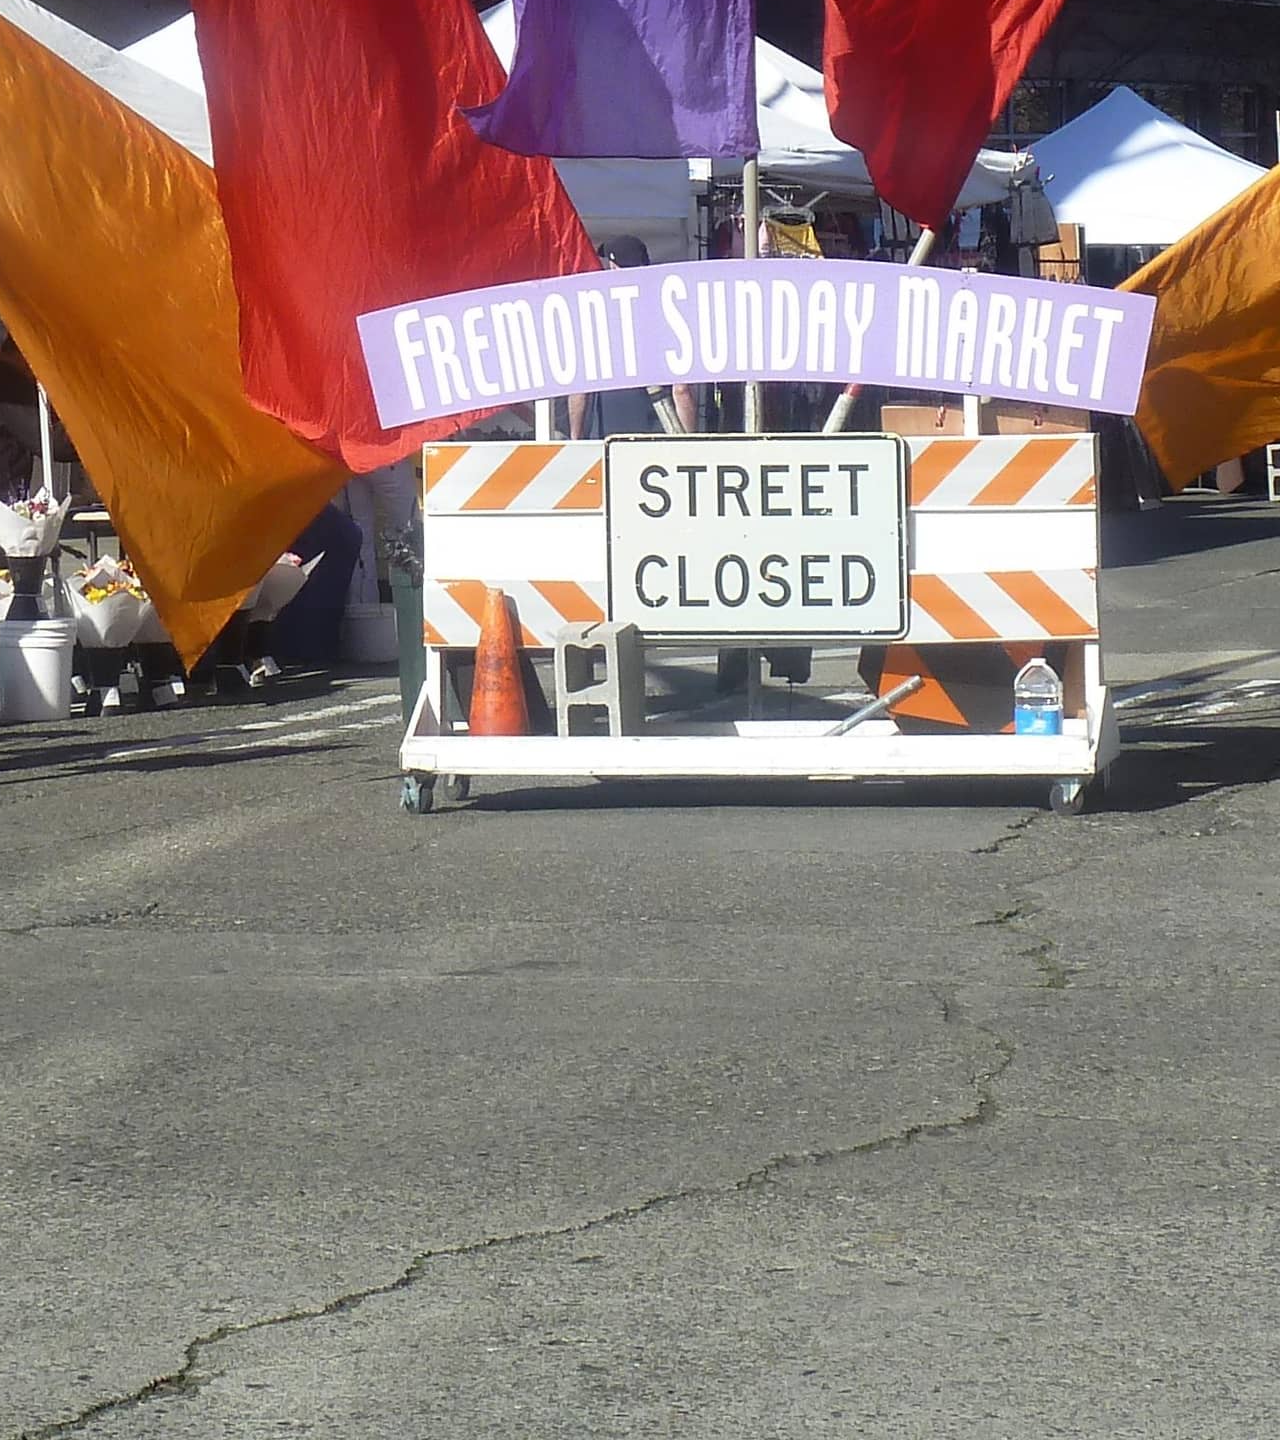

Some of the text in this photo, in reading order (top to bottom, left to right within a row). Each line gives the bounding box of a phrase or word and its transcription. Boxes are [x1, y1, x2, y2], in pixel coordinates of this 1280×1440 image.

[393, 274, 1124, 411] FREMONT SUNDAY MARKET
[638, 464, 870, 518] STREET
[634, 554, 877, 608] CLOSED
